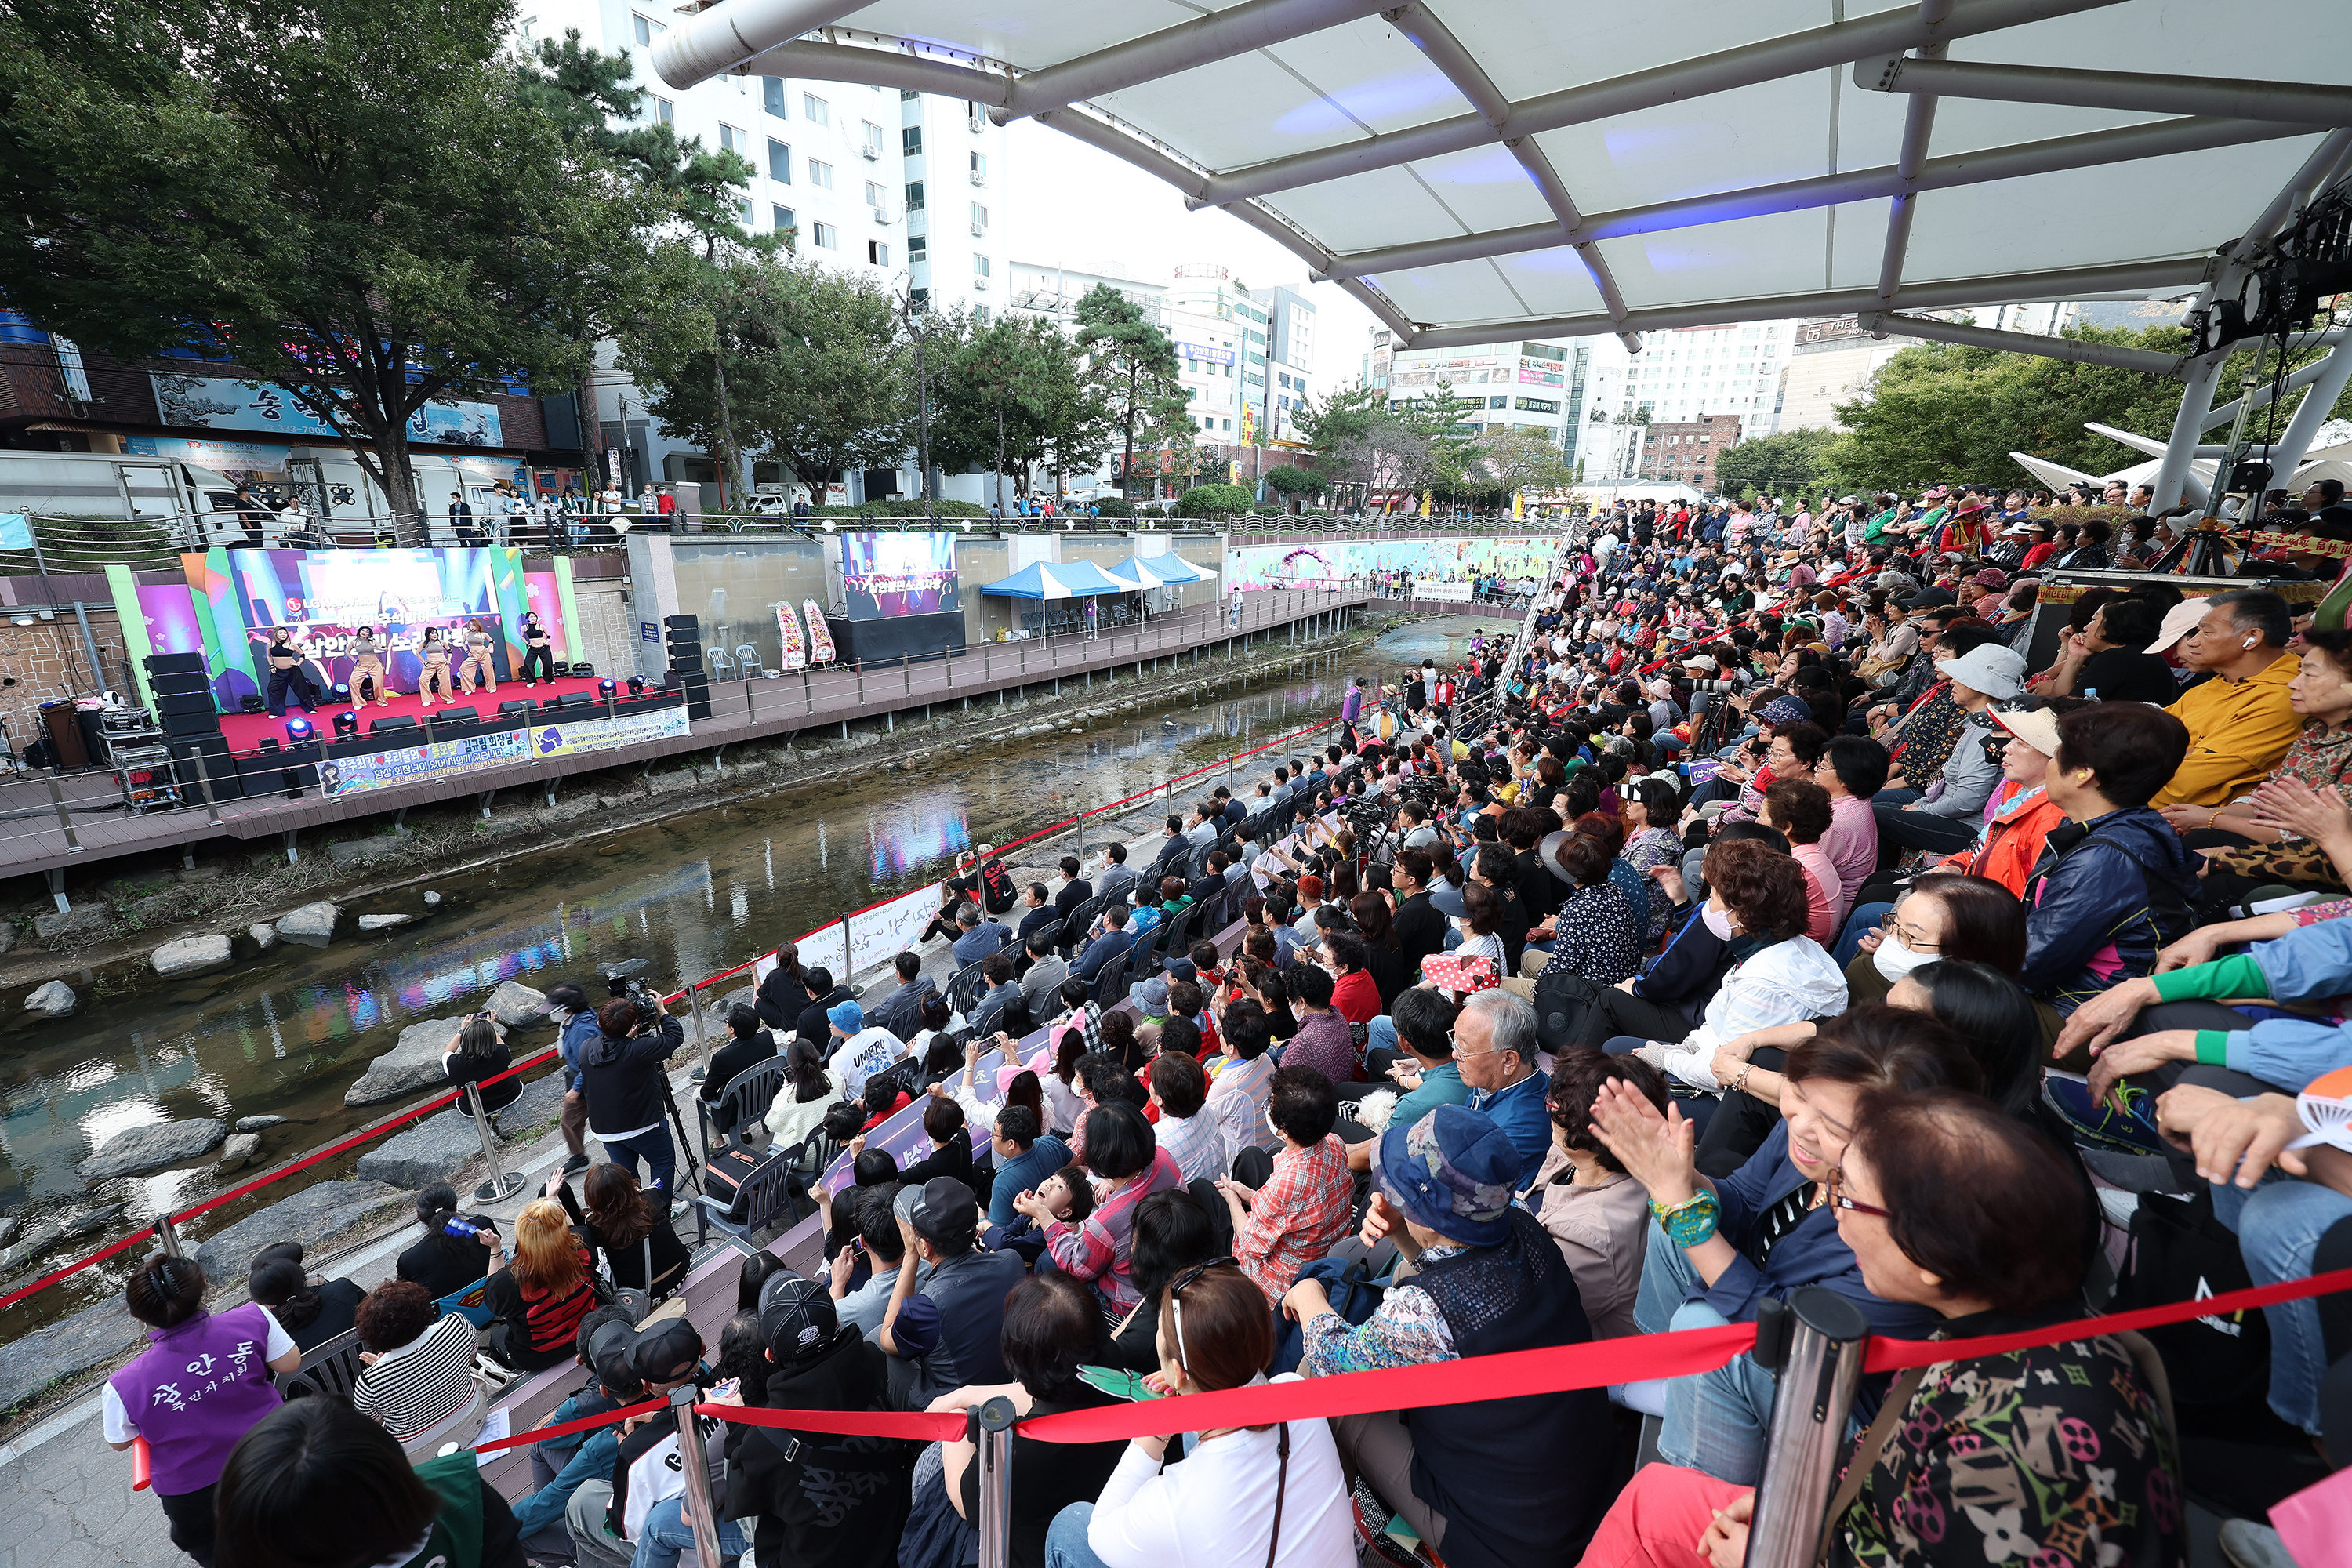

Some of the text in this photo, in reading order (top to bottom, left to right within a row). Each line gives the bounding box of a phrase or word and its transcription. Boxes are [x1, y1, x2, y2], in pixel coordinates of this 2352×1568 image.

[277, 424, 327, 435] 333-7800
[2315, 541, 2339, 554] 위험
[302, 597, 321, 609] LG
[336, 610, 431, 629] 제7회 추석맞이
[303, 632, 387, 659] 삼안민
[338, 757, 377, 773] 우주최강
[383, 748, 419, 766] 우리들의
[463, 738, 488, 753] 김규림
[488, 732, 513, 749] 회장님
[372, 767, 392, 779] 항상
[394, 761, 428, 776] 회장님이
[429, 758, 446, 770] 있어
[448, 754, 472, 767] 저희가
[472, 748, 503, 762] 있습니다
[170, 1362, 248, 1412] 주민자치회
